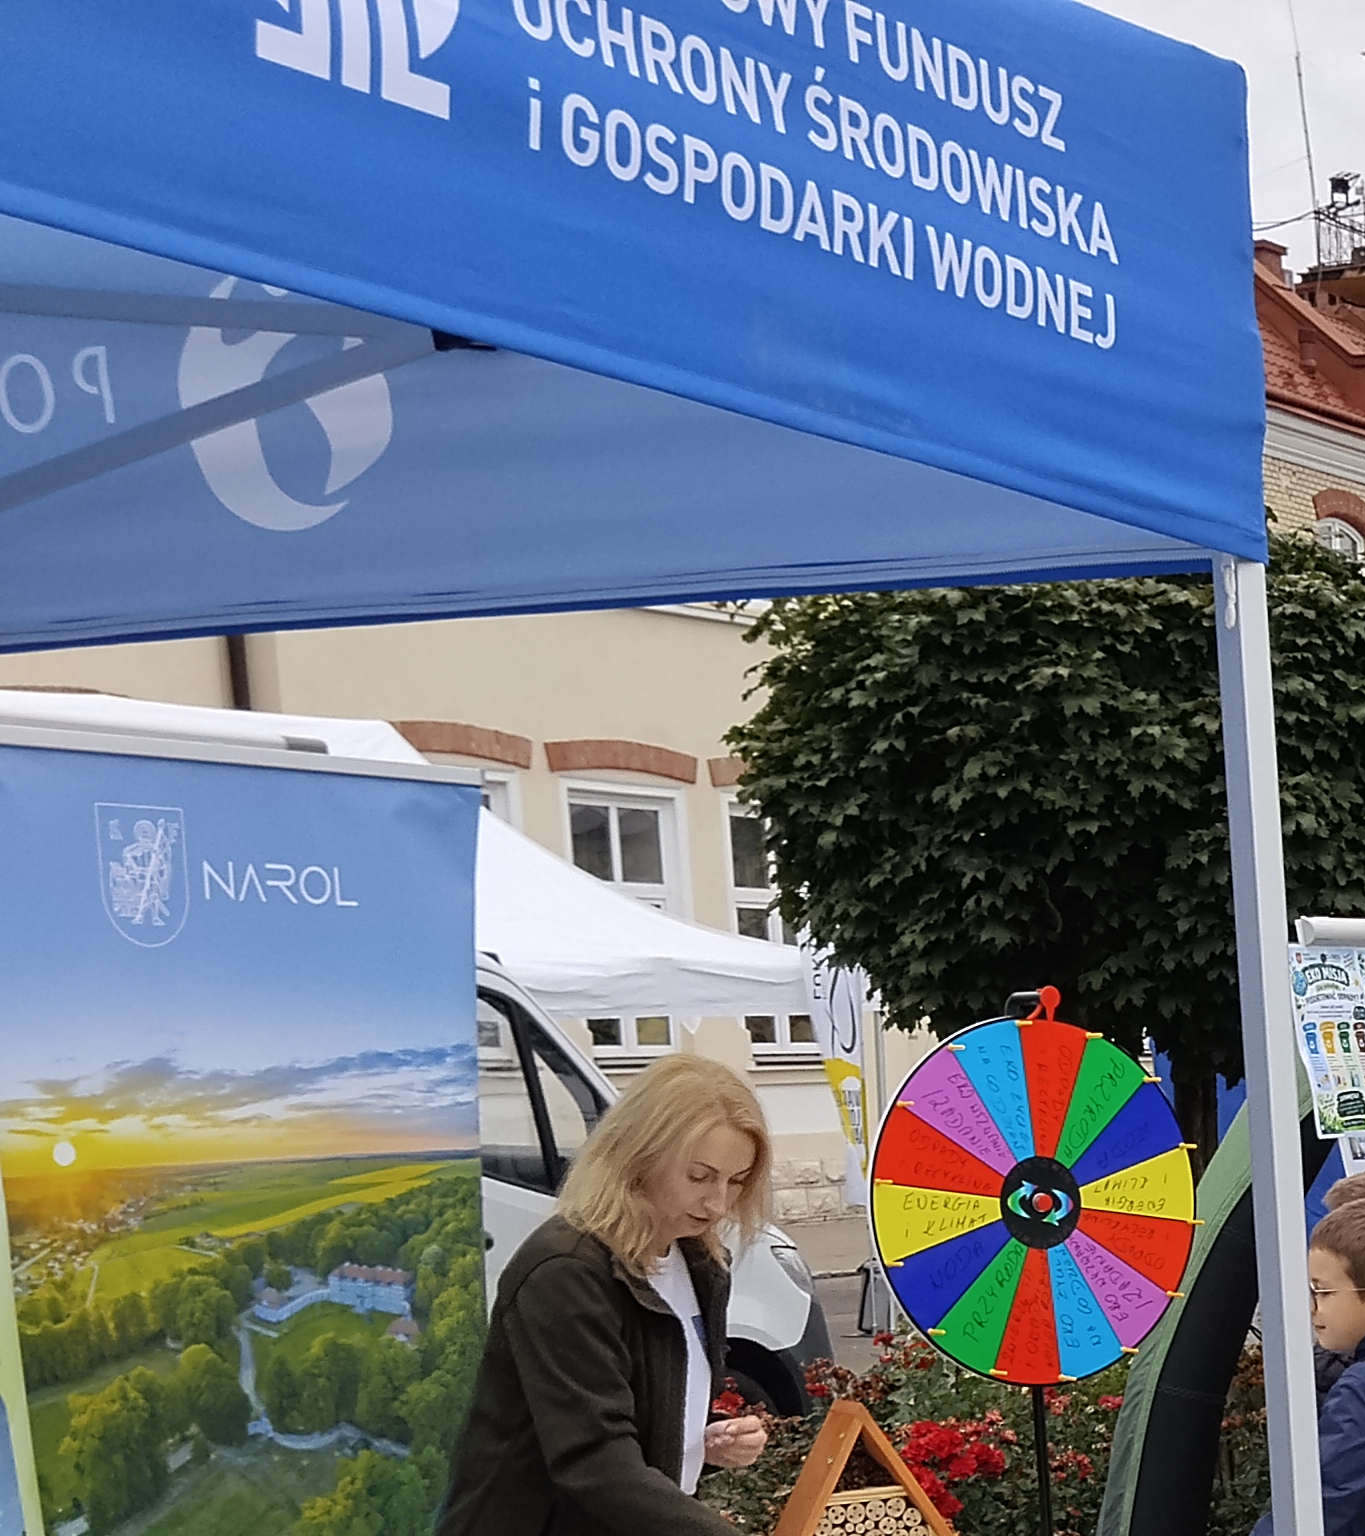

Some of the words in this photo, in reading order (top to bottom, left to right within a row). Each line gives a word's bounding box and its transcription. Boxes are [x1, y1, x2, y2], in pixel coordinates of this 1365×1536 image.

[516, 0, 792, 133] OCHRONY
[804, 66, 1119, 264] ŚRODOWISKA
[845, 0, 1066, 152] FUNDUSZ
[527, 78, 541, 150] i
[561, 93, 913, 281] GOSPODARKI
[925, 226, 1116, 350] WODNEJ
[202, 860, 359, 906] NAROL
[903, 1193, 981, 1210] ENERGIA
